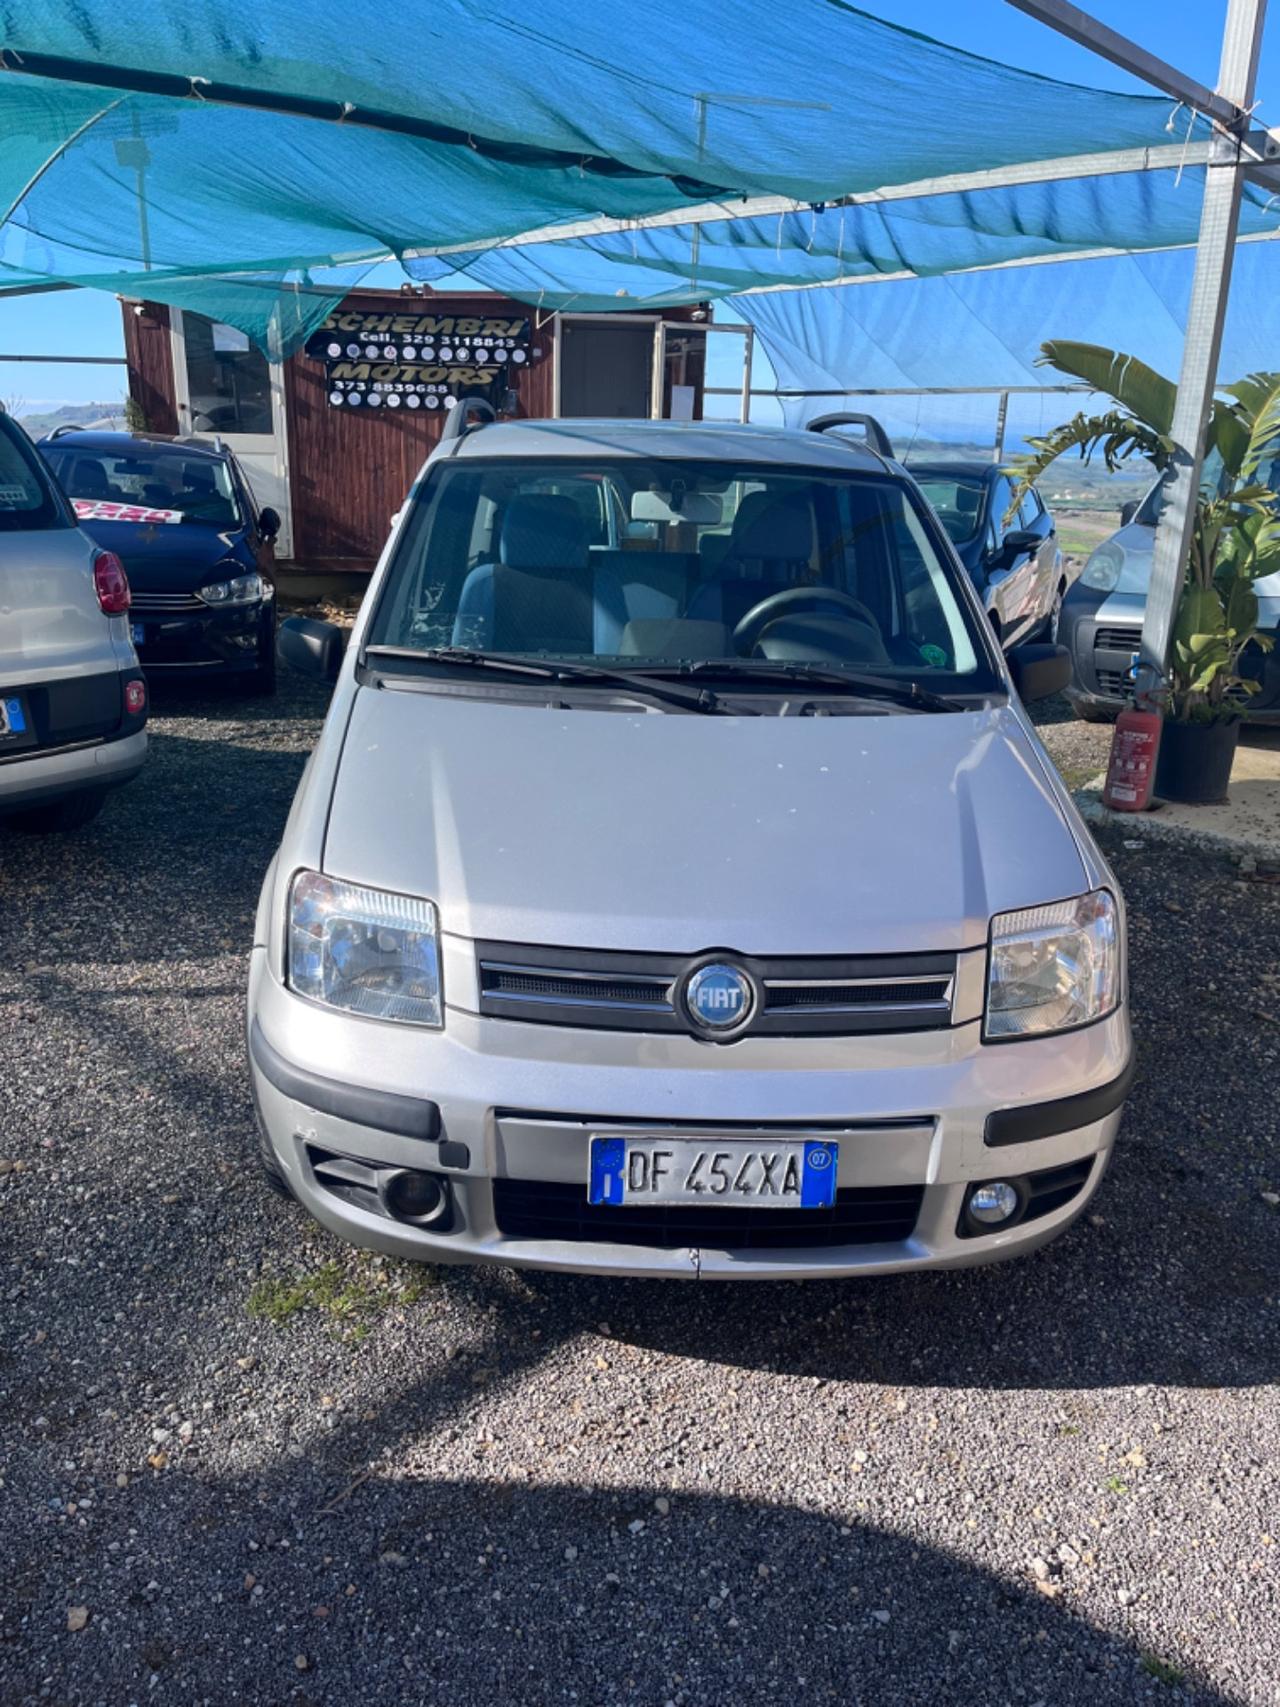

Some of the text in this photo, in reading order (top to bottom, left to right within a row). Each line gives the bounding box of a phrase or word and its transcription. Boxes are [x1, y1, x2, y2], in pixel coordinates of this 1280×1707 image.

[320, 313, 525, 337] SCHEMBRI
[402, 334, 434, 345] 329
[331, 363, 499, 385] MOTORS
[334, 381, 366, 391] 373
[697, 987, 740, 1008] FIAT
[628, 1150, 673, 1192] DF
[685, 1153, 801, 1195] 454XA
[812, 1152, 826, 1165] 07
